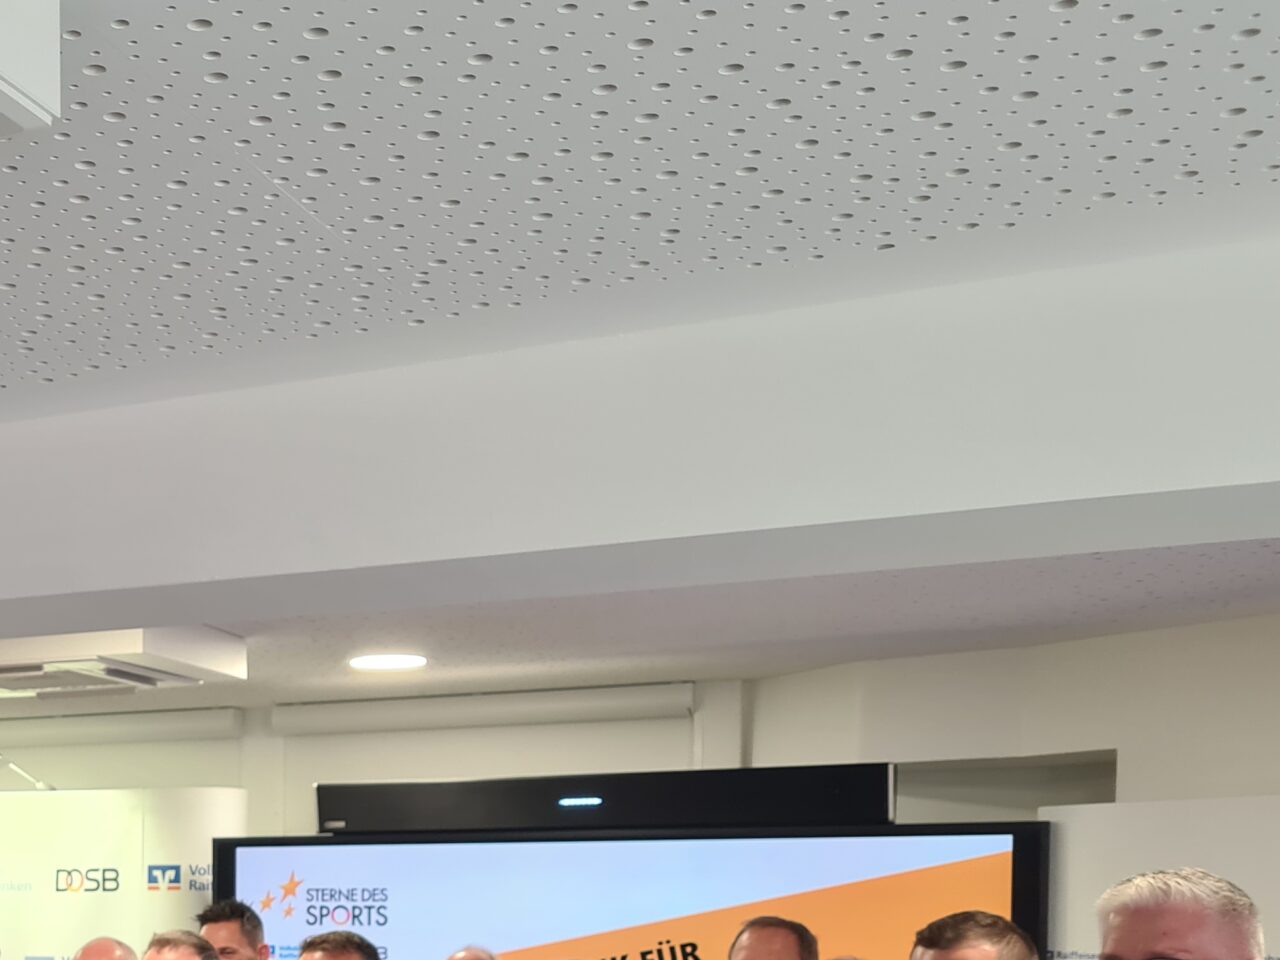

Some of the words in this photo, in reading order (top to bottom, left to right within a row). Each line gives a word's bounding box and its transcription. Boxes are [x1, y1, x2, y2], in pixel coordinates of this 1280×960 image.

[55, 868, 120, 892] DOSB
[305, 887, 359, 902] STERNE
[361, 888, 388, 902] DES
[305, 905, 388, 926] SPORTS
